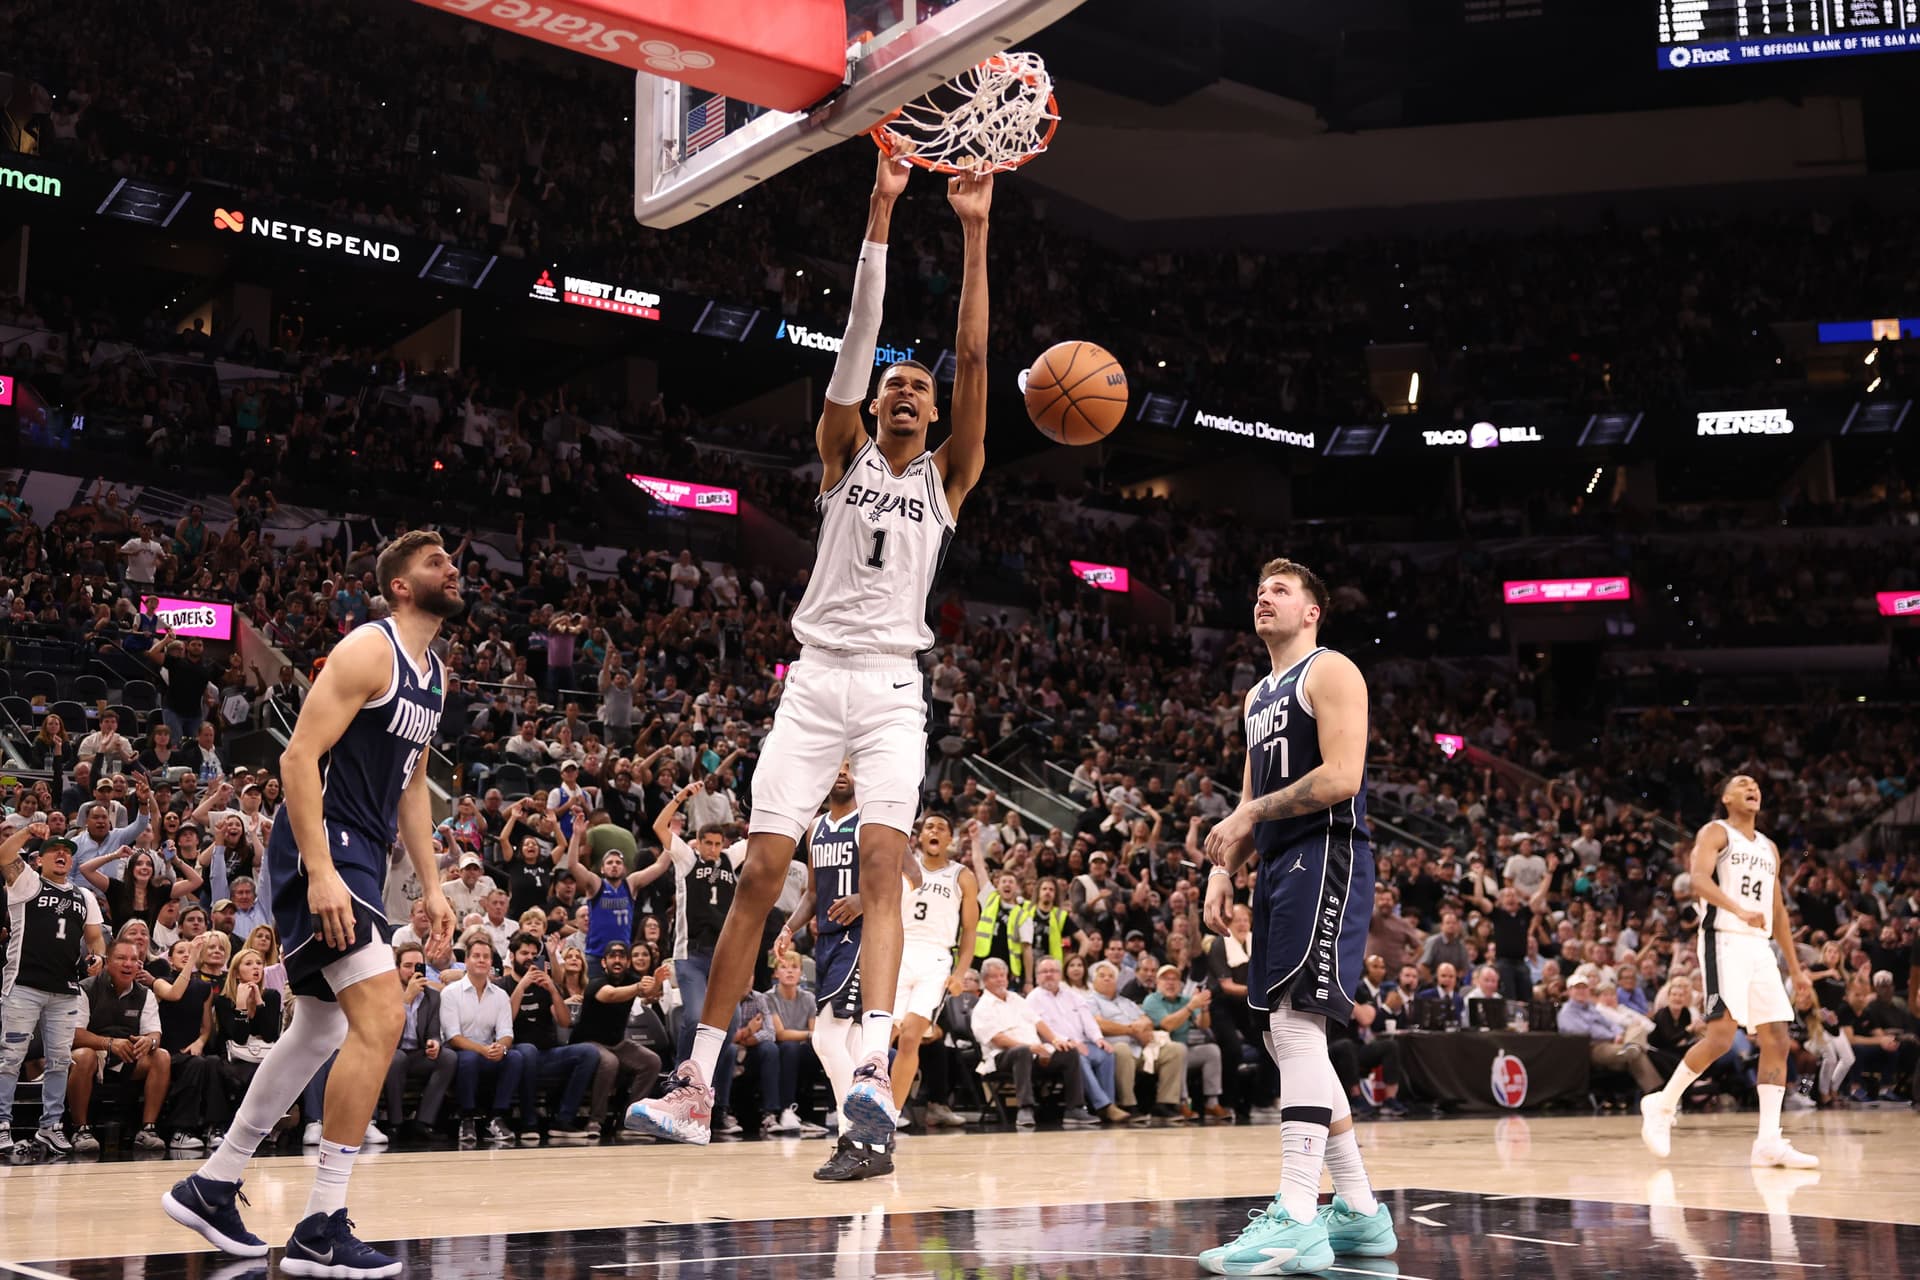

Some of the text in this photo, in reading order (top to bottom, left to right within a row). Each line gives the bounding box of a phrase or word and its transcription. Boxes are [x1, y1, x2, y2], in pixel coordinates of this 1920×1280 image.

[1692, 48, 1731, 64] Frost
[1741, 45, 1761, 58] THE
[1763, 42, 1810, 56] OFFICIAL
[1812, 39, 1841, 51] BANK
[1844, 38, 1858, 49] OF
[1861, 36, 1881, 48] THE
[1884, 34, 1906, 46] SAN
[251, 216, 400, 262] NETSPEND
[564, 276, 614, 299] WEST
[614, 286, 661, 307] LOOP
[786, 324, 914, 366] Victor pital
[1194, 410, 1314, 448] Americus Diamond
[1422, 426, 1542, 445] TACO BELL
[865, 528, 888, 572] 1
[1247, 695, 1290, 752] MAVS
[1263, 736, 1289, 779] 77
[812, 841, 853, 869] MAVS
[709, 886, 718, 905] 1
[837, 868, 852, 896] 11
[1741, 874, 1763, 902] 24
[613, 909, 630, 927] 77
[914, 902, 928, 921] 3
[55, 917, 67, 940] 1
[1315, 895, 1340, 1000] MAVERICKS
